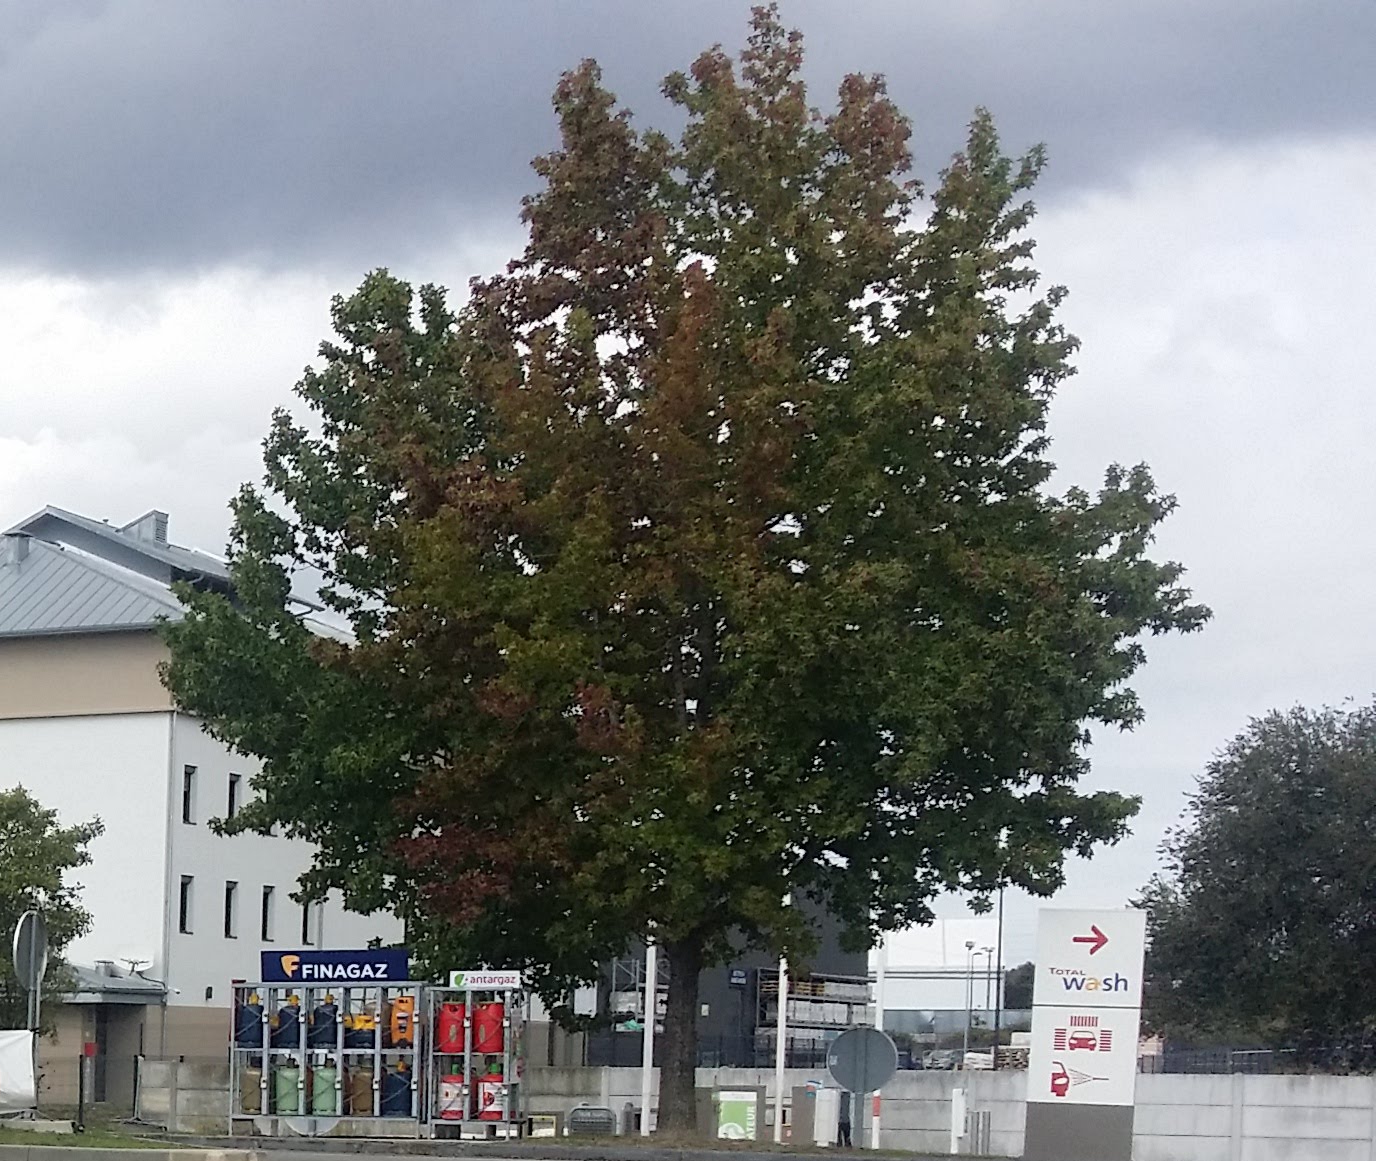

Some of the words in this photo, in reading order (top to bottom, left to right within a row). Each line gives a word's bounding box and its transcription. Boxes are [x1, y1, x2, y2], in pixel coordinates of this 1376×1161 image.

[302, 963, 388, 979] FINAGAZ
[1049, 967, 1086, 976] TOTAL
[469, 974, 516, 987] antargaz
[1062, 972, 1128, 992] wash
